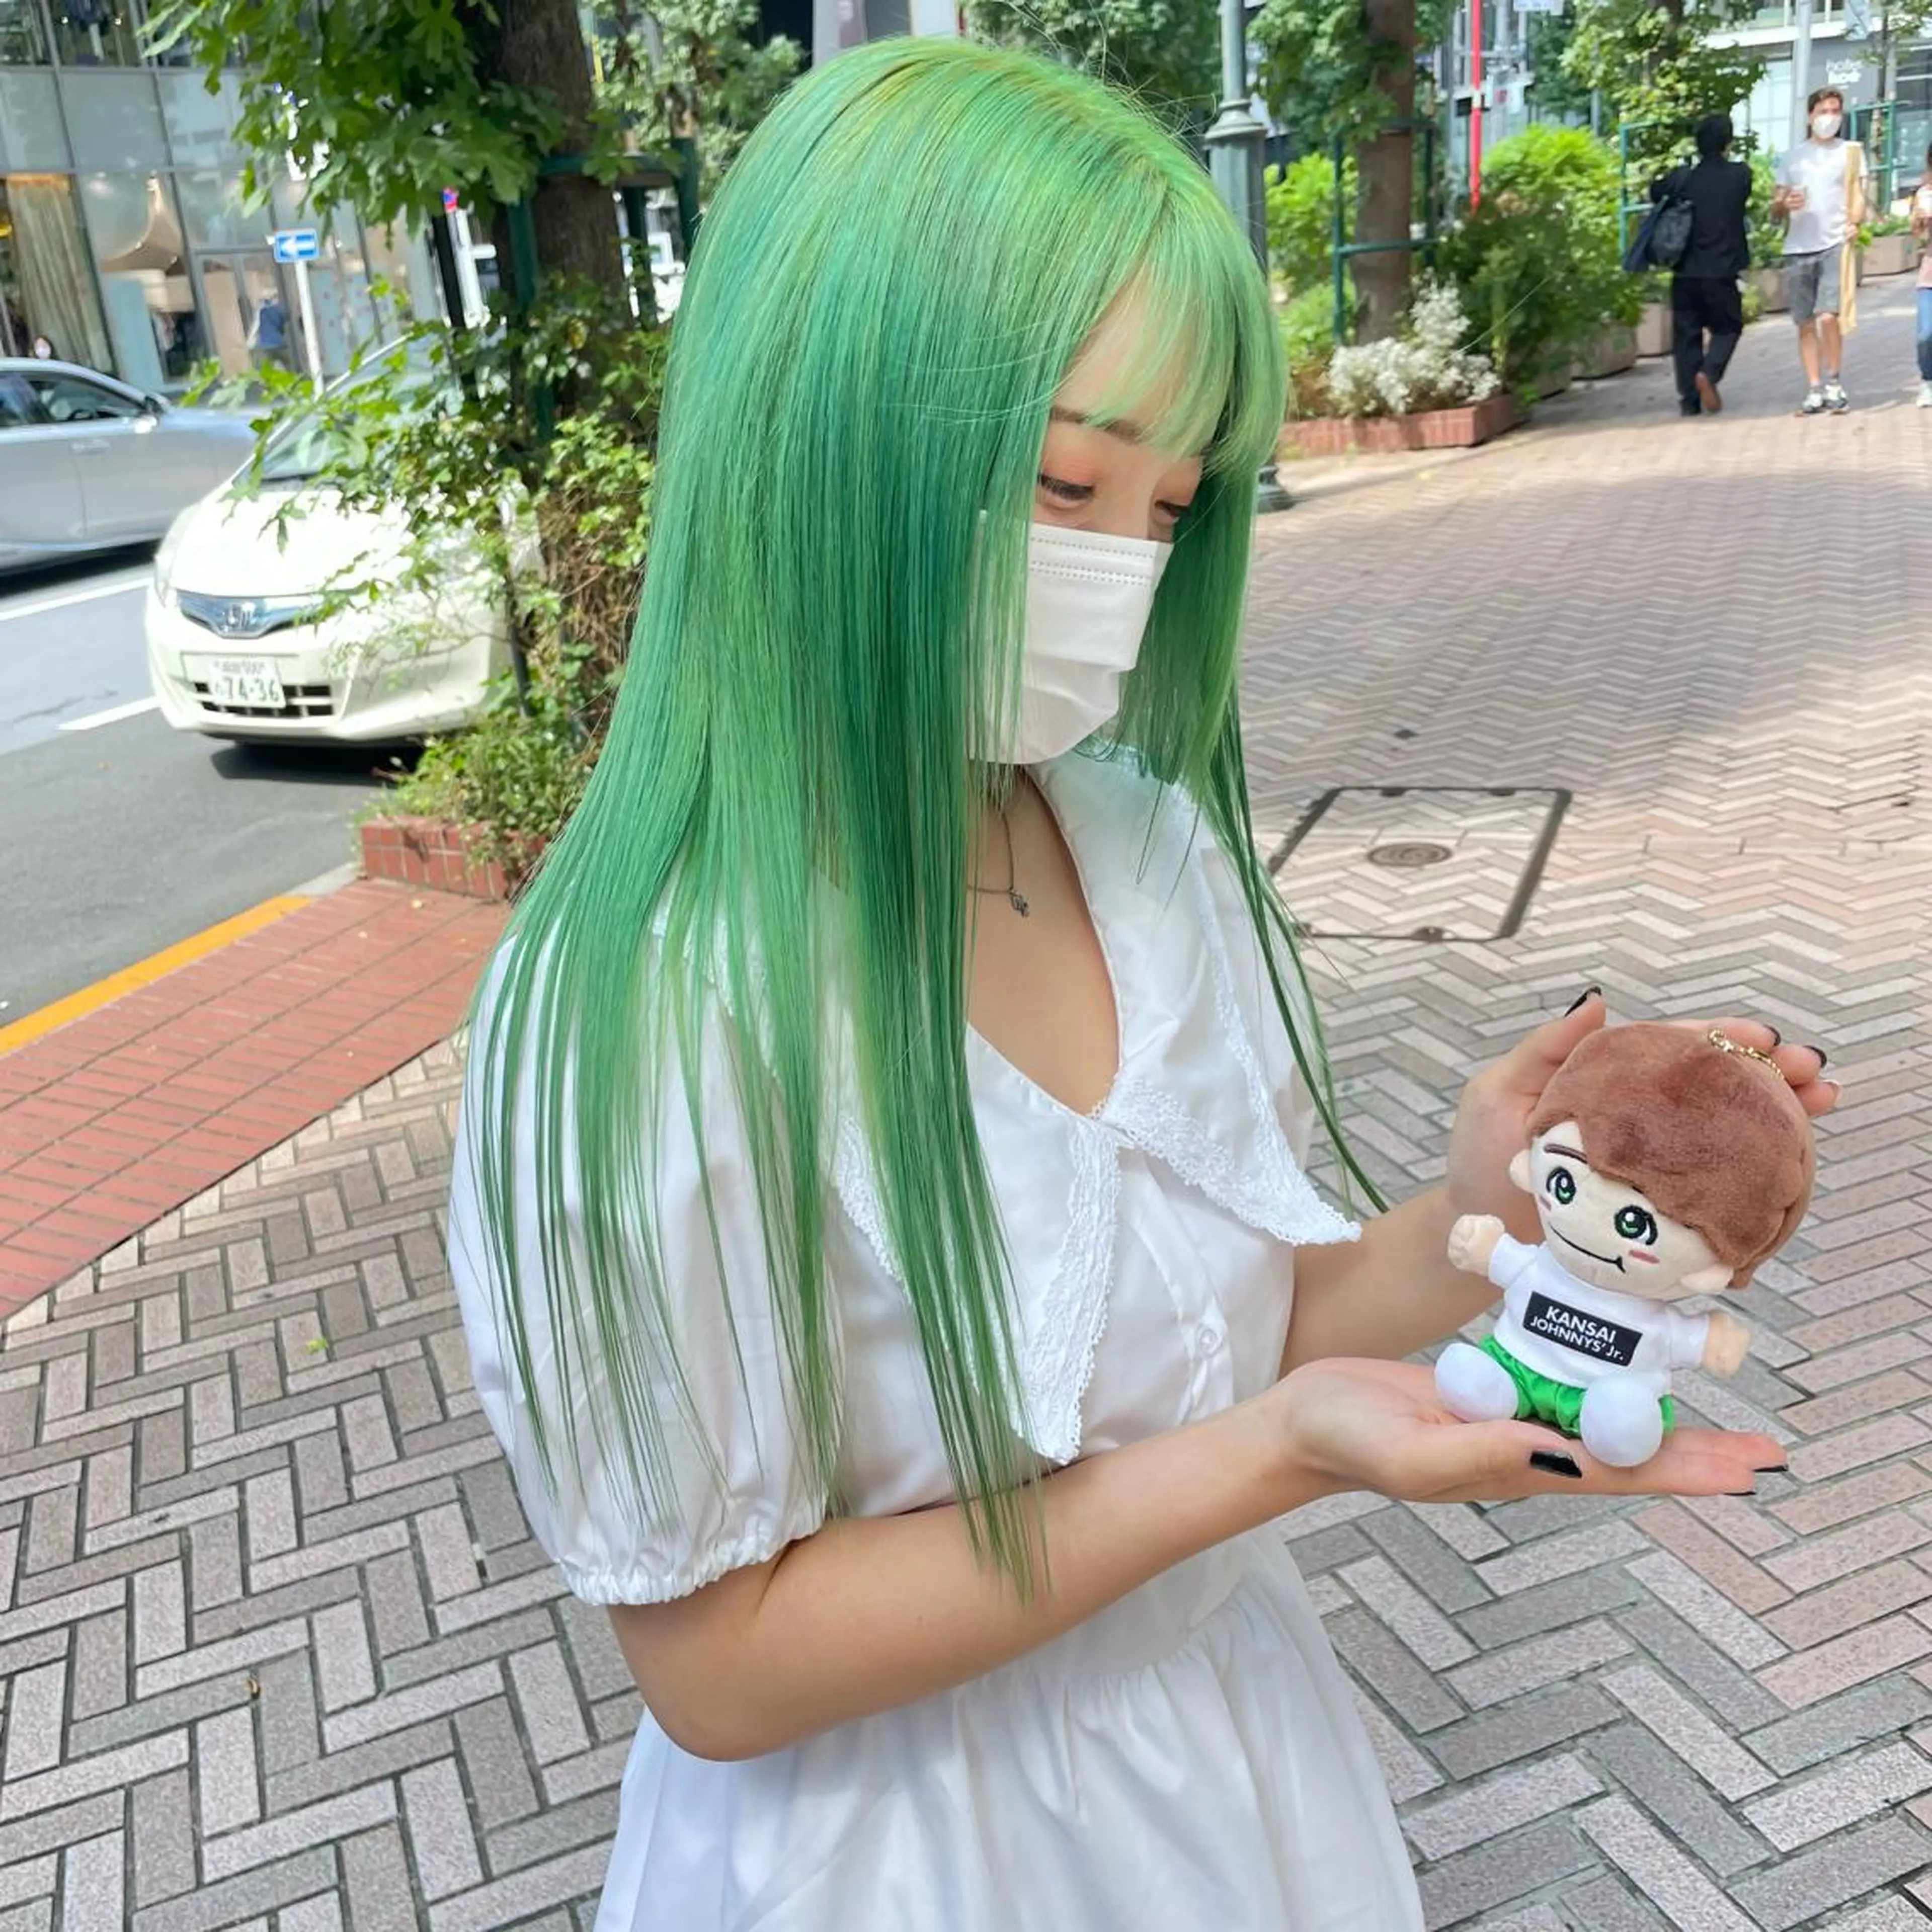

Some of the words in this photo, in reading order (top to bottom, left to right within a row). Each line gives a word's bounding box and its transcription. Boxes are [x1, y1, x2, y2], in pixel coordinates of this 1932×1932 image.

[1530, 1316, 1605, 1352] JOHNNYS'
[1605, 1345, 1624, 1360] Jr.
[1546, 1306, 1616, 1343] KANSAI
